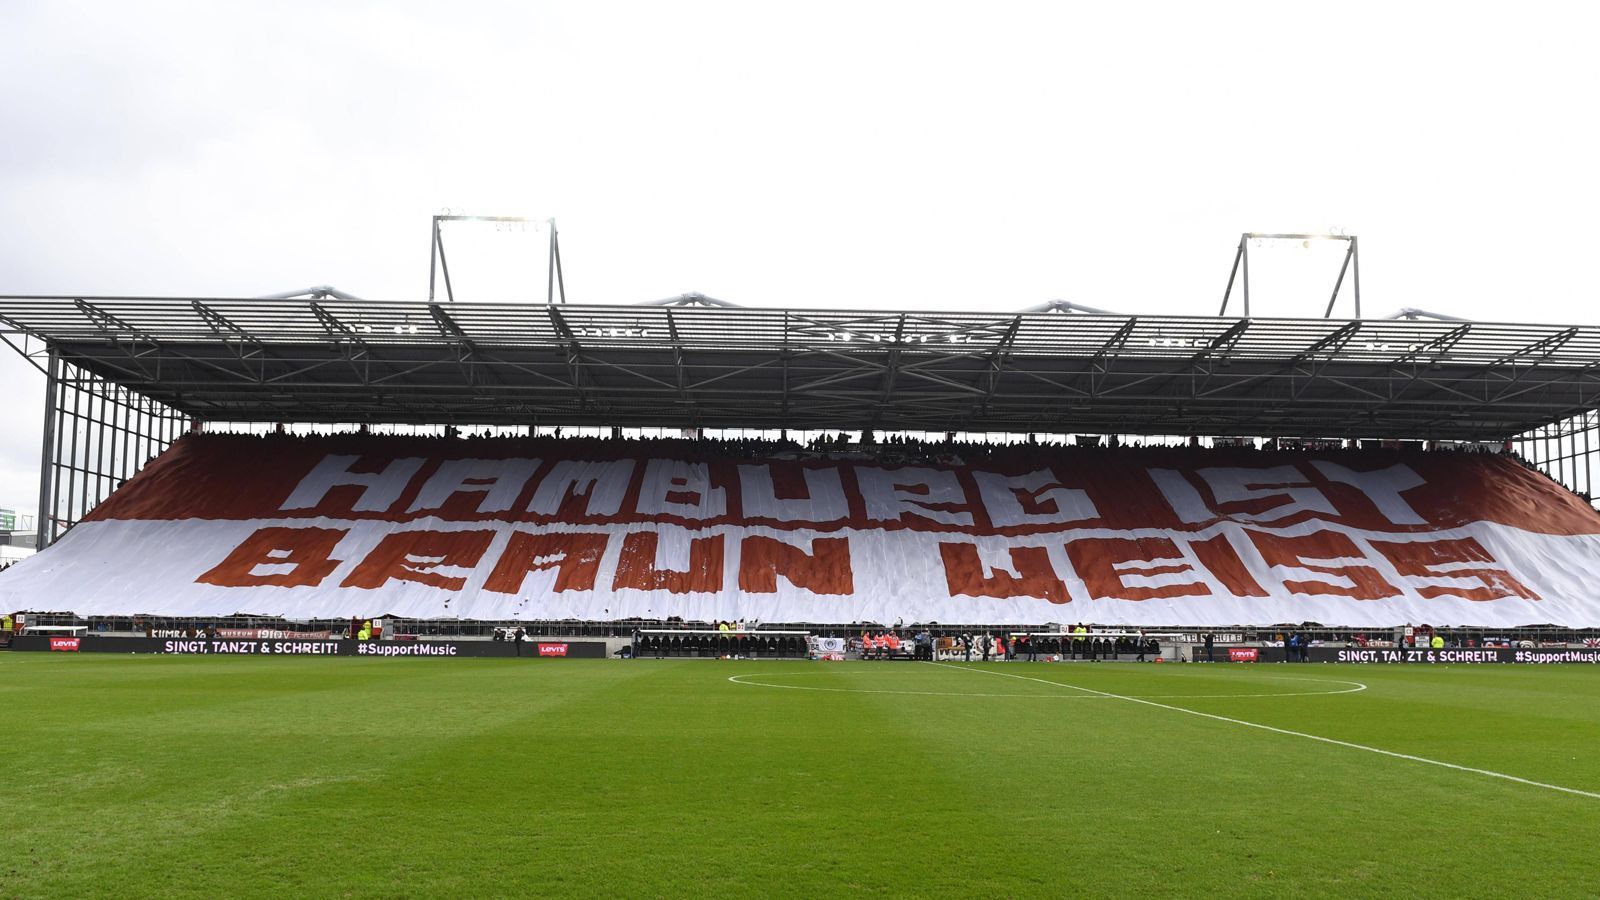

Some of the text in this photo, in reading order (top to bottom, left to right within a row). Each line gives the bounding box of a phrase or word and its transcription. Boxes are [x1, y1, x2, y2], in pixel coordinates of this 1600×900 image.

[278, 453, 1427, 528] HAMBURG IST
[194, 524, 1543, 604] BRAUN WEISS
[1201, 633, 1242, 642] SHULE
[165, 641, 338, 654] SINGT, TANZT & SCHREIT!
[357, 643, 457, 656] #SupportMusic
[1338, 650, 1378, 662] SINGT,
[1427, 651, 1436, 661] &
[1439, 651, 1497, 662] SCHREIT!
